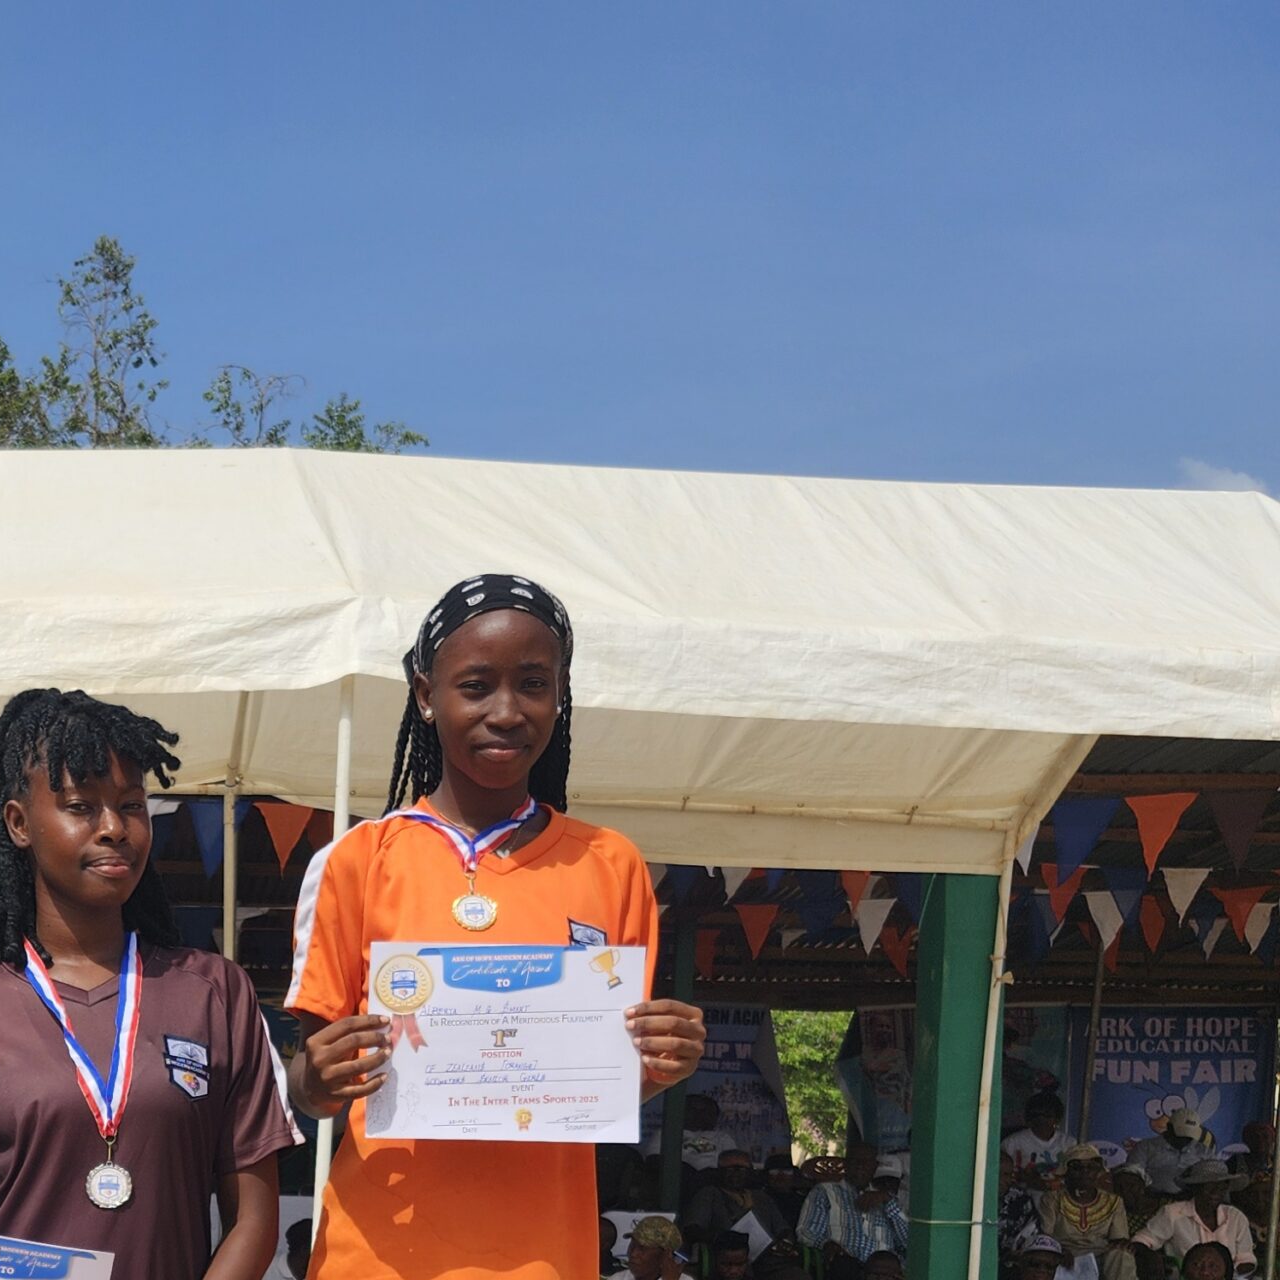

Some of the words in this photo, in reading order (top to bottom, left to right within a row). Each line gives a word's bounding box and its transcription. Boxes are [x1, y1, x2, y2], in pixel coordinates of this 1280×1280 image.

[496, 978, 511, 988] TO
[1144, 1017, 1177, 1037] OF
[1186, 1017, 1257, 1037] HOPE
[1095, 1038, 1255, 1054] EDUCATIONAL
[1092, 1058, 1160, 1083] FUN
[1170, 1058, 1257, 1084] FAIR
[511, 1084, 535, 1092] EVENT
[462, 1096, 480, 1106] THE
[482, 1096, 509, 1106] INTER
[511, 1095, 540, 1105] TEAMS
[542, 1094, 577, 1104] SPORTS
[579, 1095, 599, 1104] 2025
[0, 1266, 15, 1275] TO
